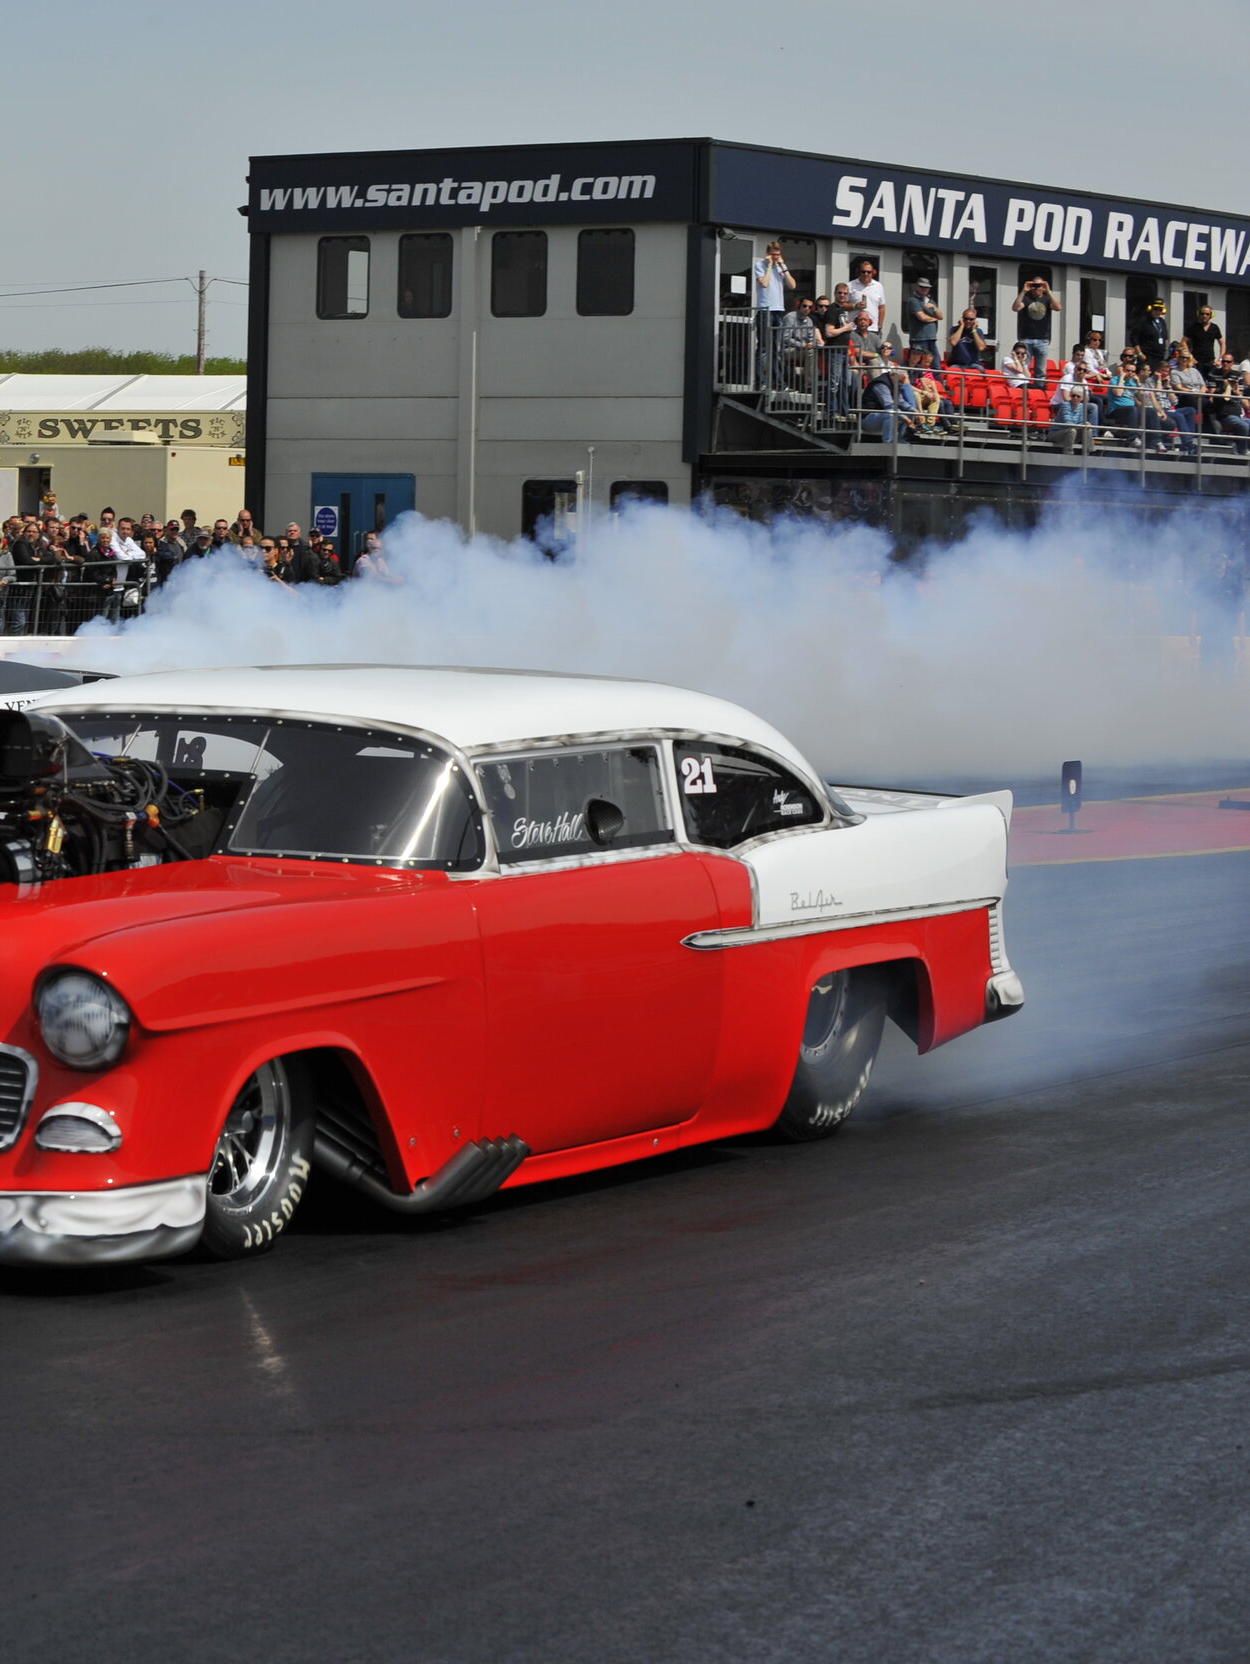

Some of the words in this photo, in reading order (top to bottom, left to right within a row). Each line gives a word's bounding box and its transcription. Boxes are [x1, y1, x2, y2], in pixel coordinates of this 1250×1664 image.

[260, 174, 656, 212] www.santapod.com
[832, 175, 987, 243] SANTA
[1002, 198, 1092, 255] POD
[681, 756, 717, 794] 21
[551, 811, 584, 843] Hall
